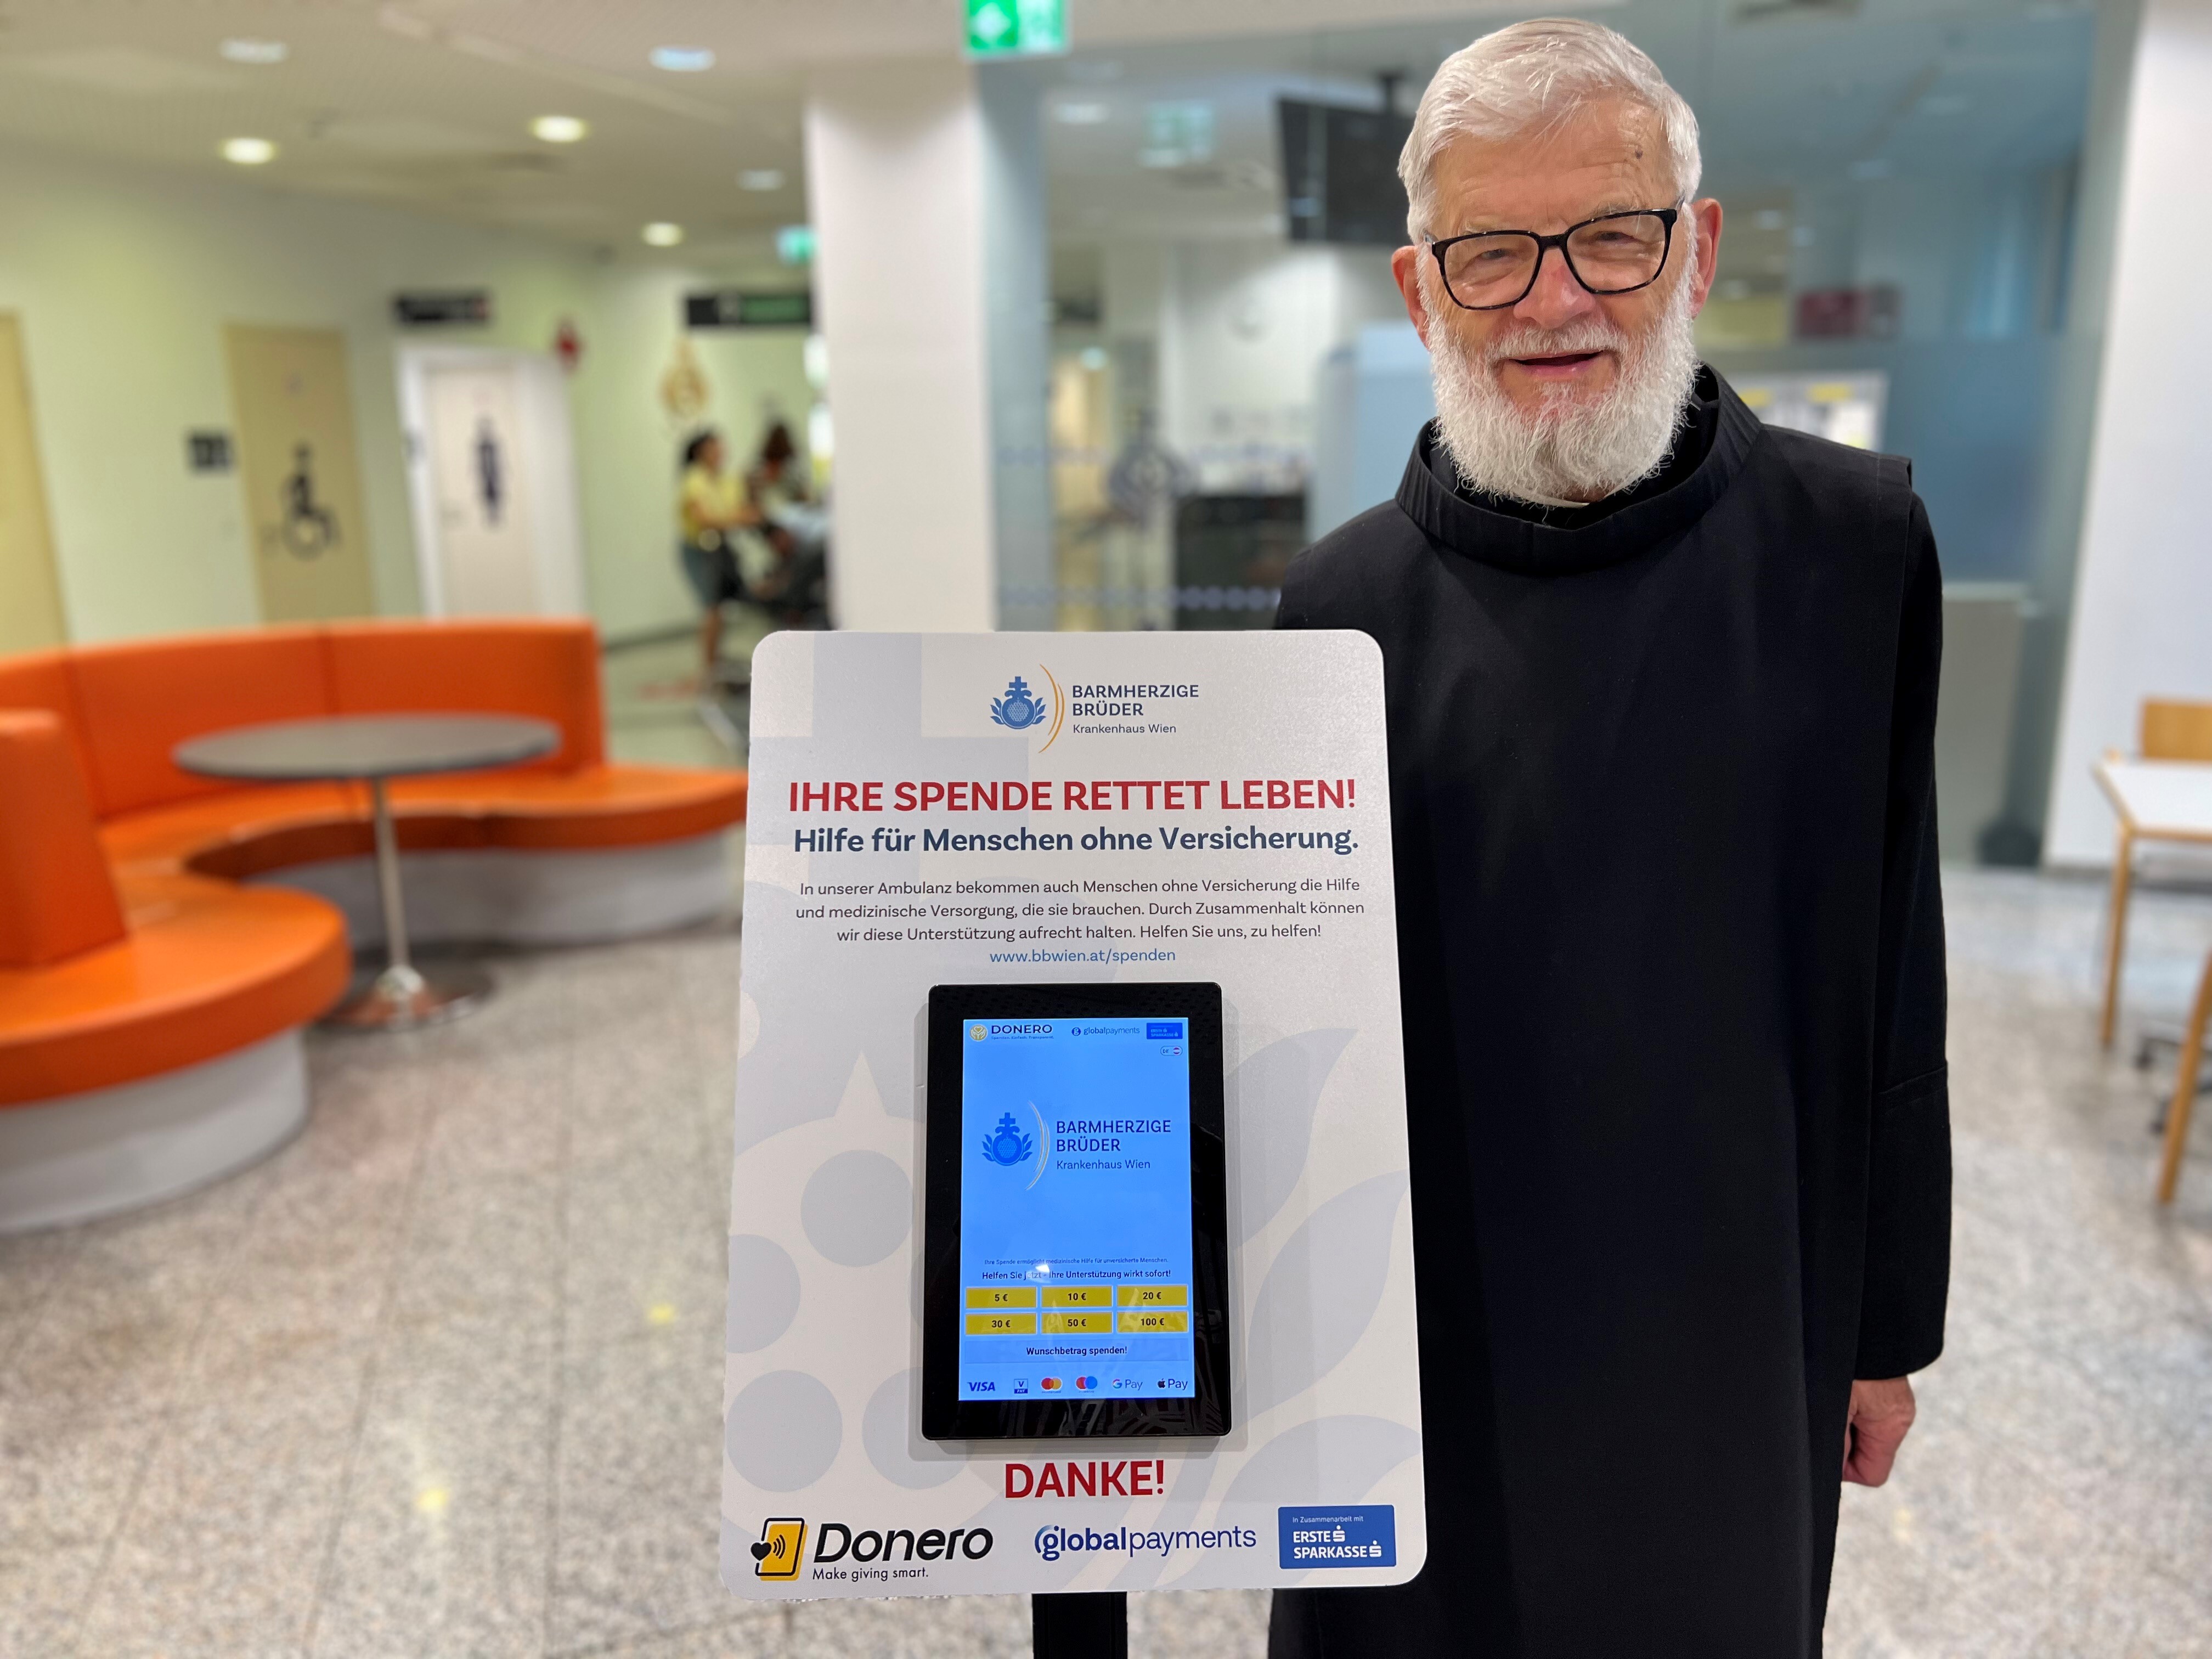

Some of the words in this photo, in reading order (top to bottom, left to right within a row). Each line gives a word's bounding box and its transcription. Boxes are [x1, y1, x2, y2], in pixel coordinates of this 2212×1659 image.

[1072, 683, 1199, 698] BARMHERZIGE
[1072, 700, 1144, 716] BRÜDER
[1073, 723, 1146, 733] Krankenhaus
[1149, 723, 1177, 732] Wien
[789, 781, 883, 811] IHRE
[894, 780, 1052, 810] SPENDE
[1064, 780, 1210, 809] RETTET
[1221, 778, 1356, 808] LEBEN!
[794, 827, 864, 852] Hilfe
[871, 827, 917, 851] für
[923, 827, 1073, 851] Menschen
[1081, 826, 1153, 850] ohne
[1159, 825, 1358, 854] Versicherung.
[800, 882, 814, 894] In
[818, 882, 874, 895] unserer
[878, 881, 952, 894] Ambulanz
[956, 880, 1039, 893] bekommen
[1043, 879, 1079, 893] auch
[1083, 879, 1158, 892] Menschen
[1162, 879, 1198, 891] ohne
[1201, 878, 1296, 895] Versicherung
[1301, 878, 1322, 891] die
[1327, 877, 1360, 890] Hilfe
[796, 905, 825, 917] und
[830, 904, 927, 917] medizinische
[930, 903, 1018, 918] Versorgung,
[1022, 902, 1043, 916] die
[1048, 902, 1068, 916] sie
[1073, 902, 1144, 915] brauchen.
[1149, 901, 1192, 915] Durch
[1196, 901, 1306, 915] Zusammenhalt
[1311, 901, 1364, 913] können
[837, 928, 860, 940] wir
[864, 927, 903, 940] diese
[907, 926, 1015, 941] Unterstützung
[1019, 926, 1081, 939] aufrecht
[1086, 925, 1136, 939] halten.
[1141, 924, 1188, 938] Helfen
[1192, 924, 1213, 937] Sie
[1217, 924, 1247, 940] uns,
[1251, 924, 1268, 936] zu
[1272, 923, 1322, 937] helfen!
[990, 948, 1176, 964] www.bbwien.at/spenden
[991, 1025, 1052, 1034] DONERO
[1084, 1026, 1140, 1035] globalpayments
[1057, 1120, 1171, 1133] BARMHERZIGE
[1057, 1136, 1121, 1152] BRÜDER
[1057, 1160, 1122, 1169] Krankenhaus
[1125, 1159, 1150, 1169] Wien
[1066, 1270, 1121, 1279] Unterstützung
[1080, 1293, 1086, 1301] €
[1159, 1318, 1165, 1326] €
[1026, 1347, 1086, 1356] Wunschbetrag
[1090, 1346, 1127, 1356] spenden!
[968, 1382, 996, 1392] VISA
[1125, 1380, 1143, 1390] Pay
[1168, 1379, 1188, 1390] Pay
[1005, 1460, 1165, 1498] DANKE!
[814, 1522, 993, 1564] Donero
[1042, 1525, 1256, 1561] globalpayments
[1293, 1531, 1330, 1543] ERSTE
[1294, 1546, 1367, 1559] SPARKASSE
[812, 1567, 847, 1580] Make
[851, 1566, 889, 1582] giving
[893, 1566, 929, 1578] smart.
